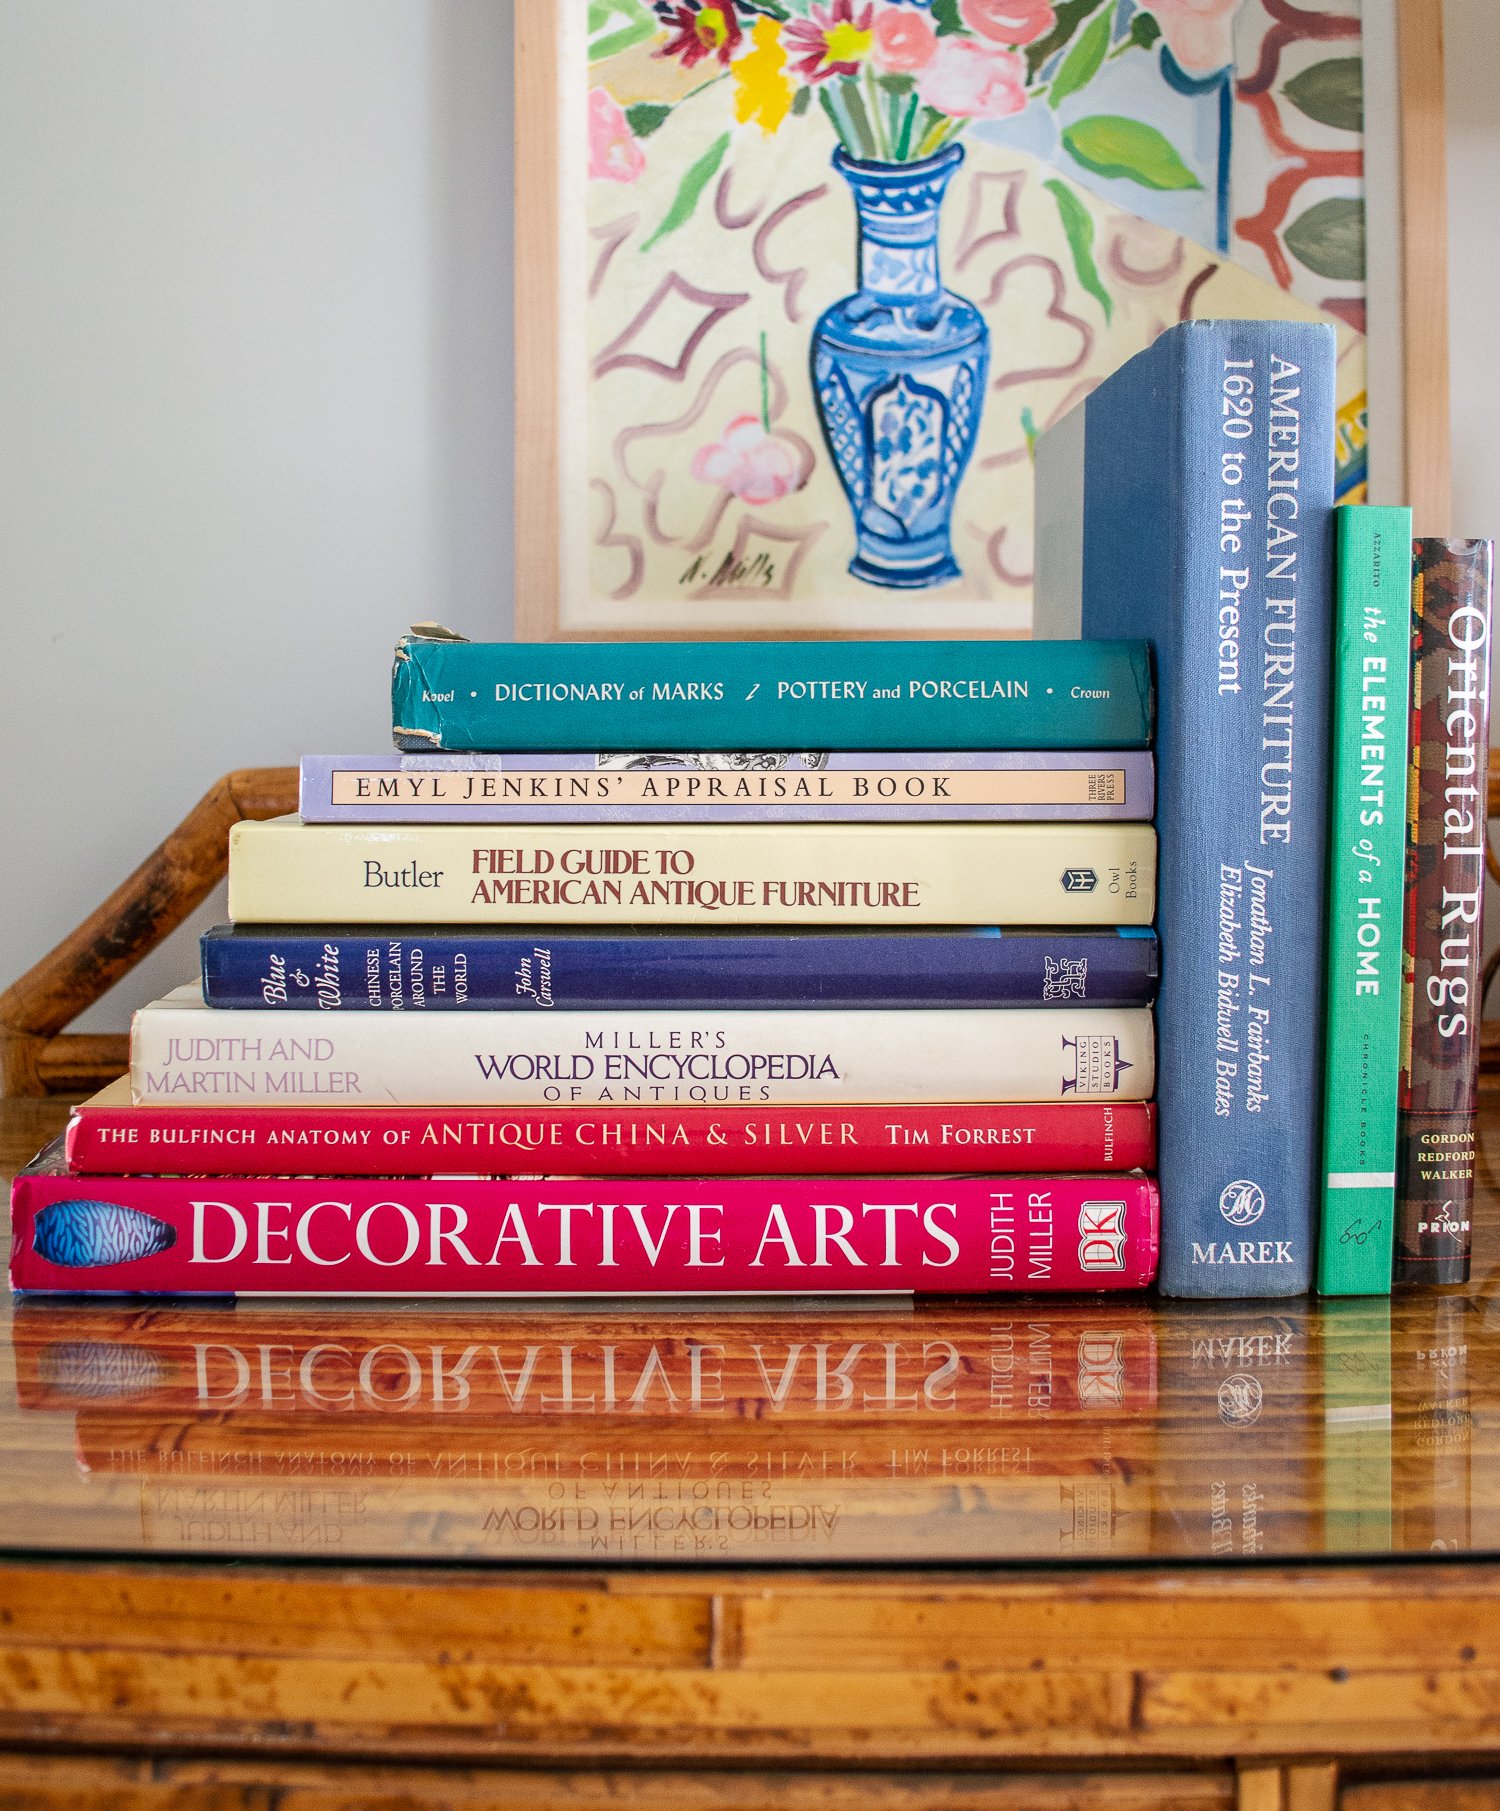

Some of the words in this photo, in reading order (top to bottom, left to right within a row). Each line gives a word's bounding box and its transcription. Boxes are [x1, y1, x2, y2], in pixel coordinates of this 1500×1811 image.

[1220, 358, 1254, 438] 1620
[1221, 453, 1244, 486] to
[1264, 353, 1302, 581] AMERICAN
[1220, 500, 1251, 554] the
[1372, 532, 1381, 588] AZZARITO
[1218, 566, 1250, 696] Present
[1363, 606, 1387, 643] the
[422, 690, 455, 702] Kovel
[495, 683, 624, 701] DICTIONARY
[629, 686, 646, 700] of
[652, 682, 725, 700] MARKS
[777, 681, 868, 699] POTTERY
[872, 684, 901, 699] and
[909, 680, 1029, 698] PORCELAIN
[1070, 686, 1110, 699] Crown
[1259, 598, 1297, 846] FURNITURE
[1360, 657, 1387, 826] ELEMENTS
[1443, 606, 1488, 860] Oriental
[356, 778, 446, 797] EMYL
[642, 777, 834, 797] APPRAISAL
[853, 777, 951, 797] BOOK
[1088, 774, 1097, 801] THREE
[1097, 774, 1106, 801] RIVERS
[1106, 774, 1115, 801] PRESS
[472, 850, 555, 874] FIELD
[560, 849, 650, 875] GUIDE
[655, 850, 695, 874] TO
[1352, 838, 1382, 867] of
[364, 860, 444, 888] Butler
[1108, 867, 1120, 894] Owl
[1125, 861, 1137, 899] Books
[1358, 869, 1373, 884] a
[471, 879, 622, 904] AMERICAN
[629, 880, 756, 910] ANTIQUE
[762, 881, 921, 907] FURNITURE
[1218, 863, 1243, 963] Elizabeth
[1245, 860, 1275, 965] Jonathan
[1355, 897, 1382, 997] HOME
[1427, 886, 1481, 1038] Rugs
[260, 953, 288, 1005] Blue
[289, 968, 310, 987] &
[314, 943, 342, 1009] White
[367, 948, 382, 1007] CHINESE
[411, 948, 426, 1007] AROUND
[433, 965, 446, 994] THE
[455, 953, 469, 1004] WORLD
[514, 957, 537, 997] John
[533, 947, 555, 1007] Carswell
[1248, 972, 1271, 996] L.
[1216, 969, 1239, 1052] Bidwell
[163, 1038, 262, 1067] JUDITH
[268, 1038, 335, 1061] AND
[475, 1054, 594, 1080] WORLD
[604, 1053, 841, 1080] ENCYCLOPEDIA
[1091, 1041, 1099, 1088] STUDIO
[1245, 1004, 1270, 1113] Fairbanks
[146, 1071, 256, 1093] MARTIN
[265, 1072, 362, 1093] MILLER
[544, 1086, 582, 1101] OF
[598, 1085, 770, 1103] ANTIQUES
[1214, 1058, 1238, 1117] Bates
[98, 1128, 139, 1143] THE
[149, 1128, 256, 1144] BULFINCH
[267, 1129, 372, 1144] ANATOMY
[383, 1129, 411, 1144] OF
[420, 1123, 563, 1150] ANTIQUE
[576, 1123, 690, 1145] CHINA
[706, 1123, 728, 1145] &
[744, 1123, 859, 1145] SILVER
[1104, 1107, 1113, 1161] BULFINCH
[1421, 1133, 1475, 1144] GORDON
[1418, 1151, 1475, 1162] REDFORD
[1421, 1169, 1473, 1180] WALKER
[188, 1201, 725, 1267] DECORATIVE
[748, 1202, 961, 1267] ARTS
[990, 1193, 1015, 1281] JUDITH
[1027, 1192, 1053, 1279] MILLER
[1084, 1207, 1119, 1265] DK
[1418, 1220, 1470, 1233] PRION
[1191, 1241, 1294, 1264] MAREK
